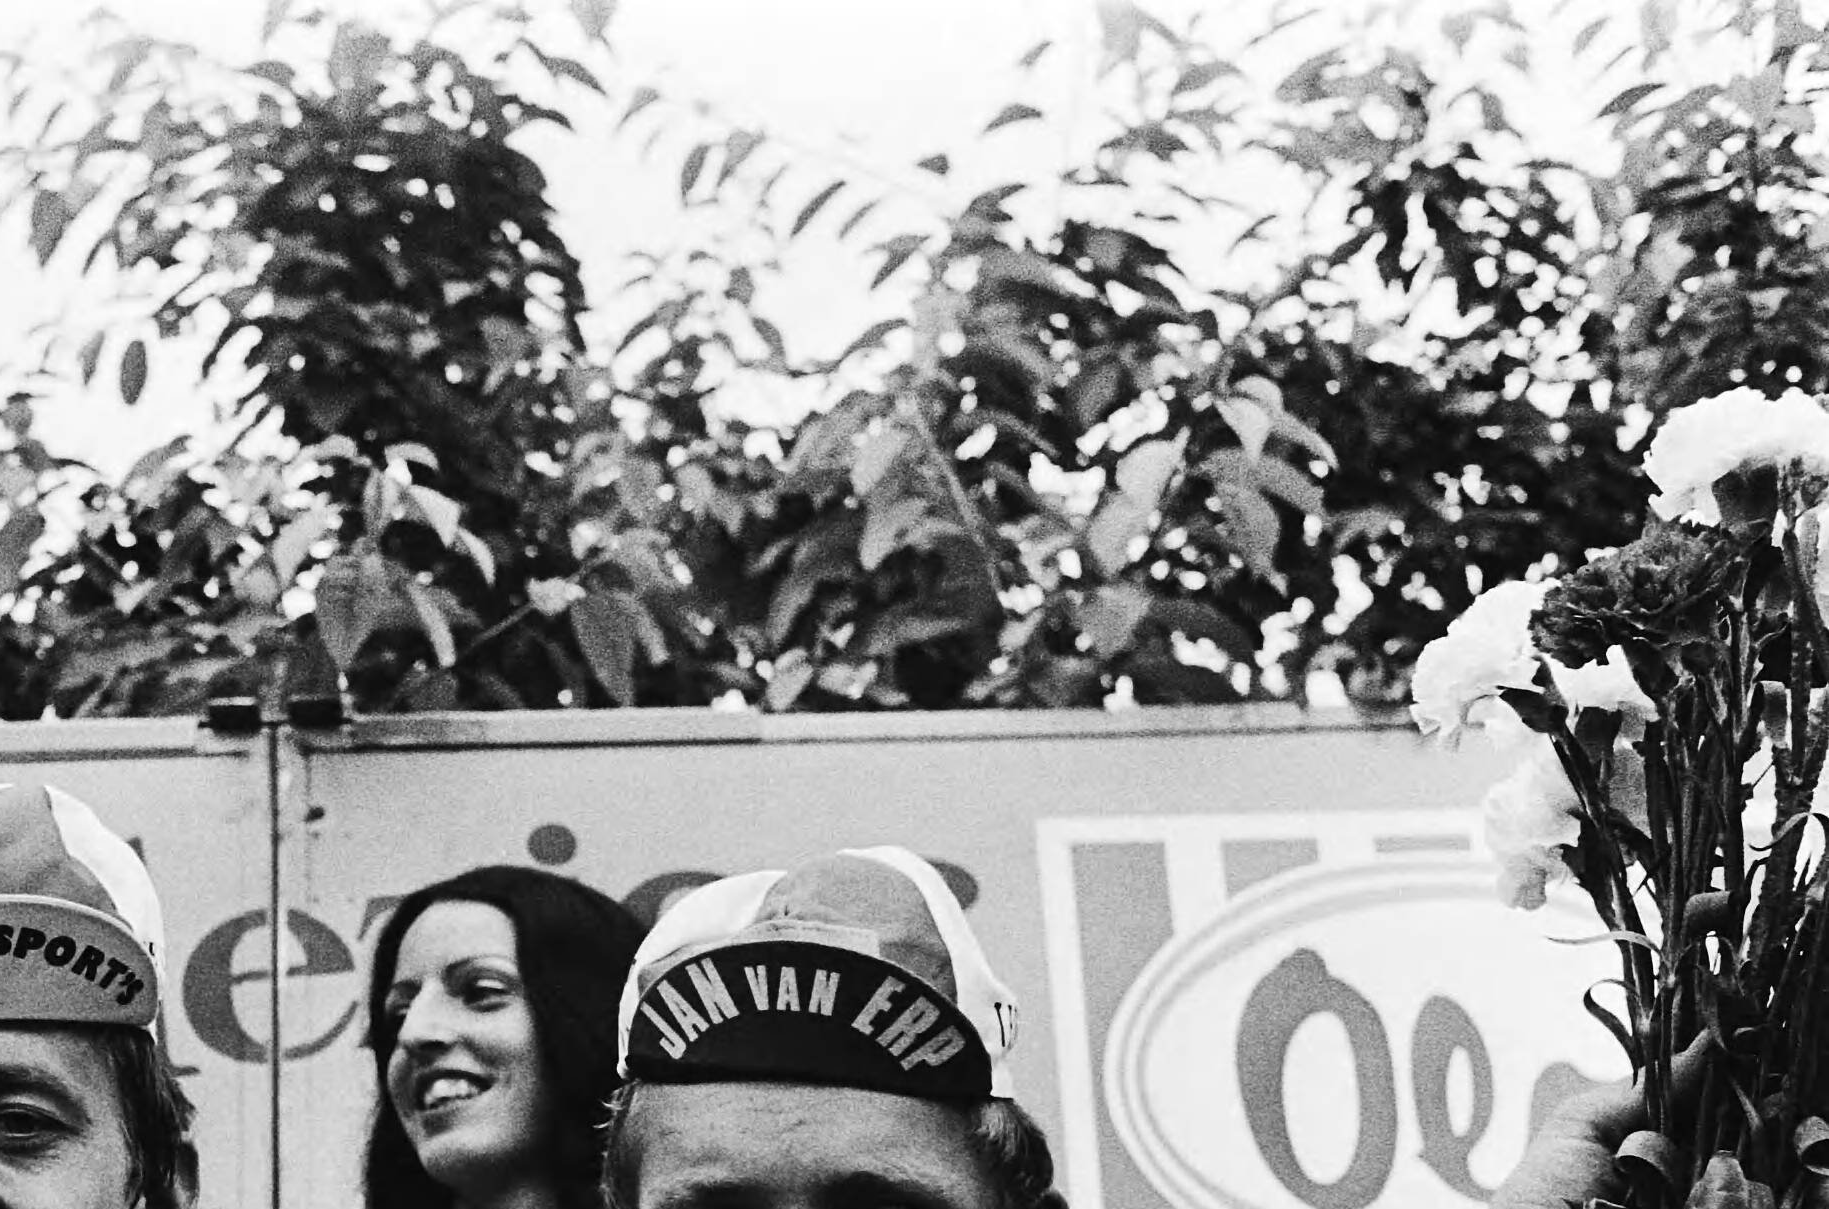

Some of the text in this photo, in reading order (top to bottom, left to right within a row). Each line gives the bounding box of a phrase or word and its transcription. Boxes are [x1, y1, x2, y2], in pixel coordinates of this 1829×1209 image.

[640, 957, 740, 1060] JAN
[744, 964, 841, 1017] VAN
[851, 975, 967, 1072] ERP
